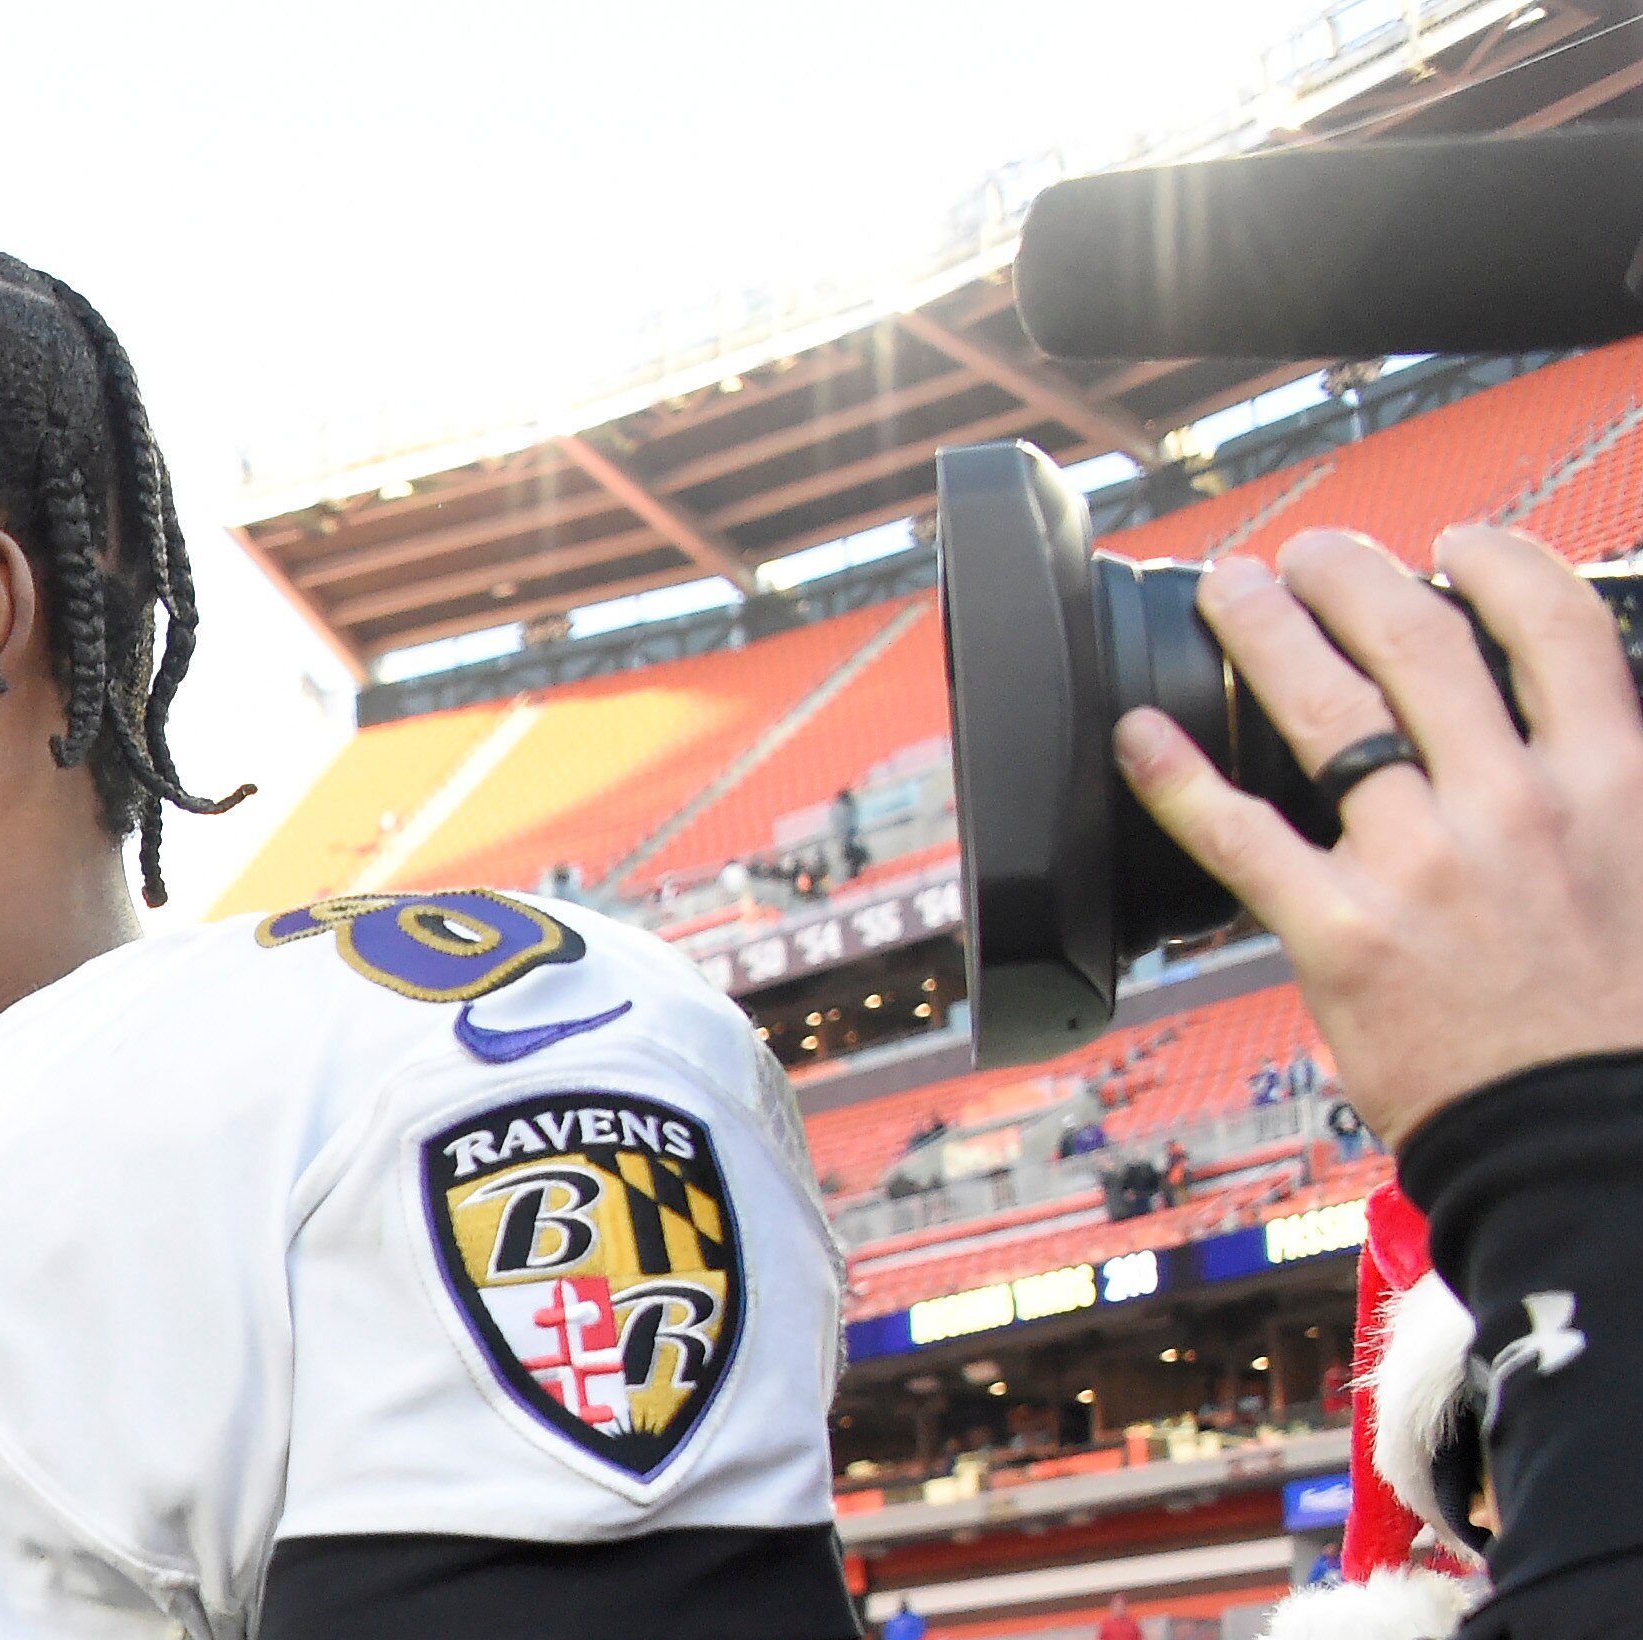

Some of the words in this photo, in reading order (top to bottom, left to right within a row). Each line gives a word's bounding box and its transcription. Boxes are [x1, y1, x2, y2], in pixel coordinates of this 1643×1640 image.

[444, 1107, 696, 1178] RAVENS
[455, 1162, 609, 1281] B
[612, 1278, 716, 1394] R
